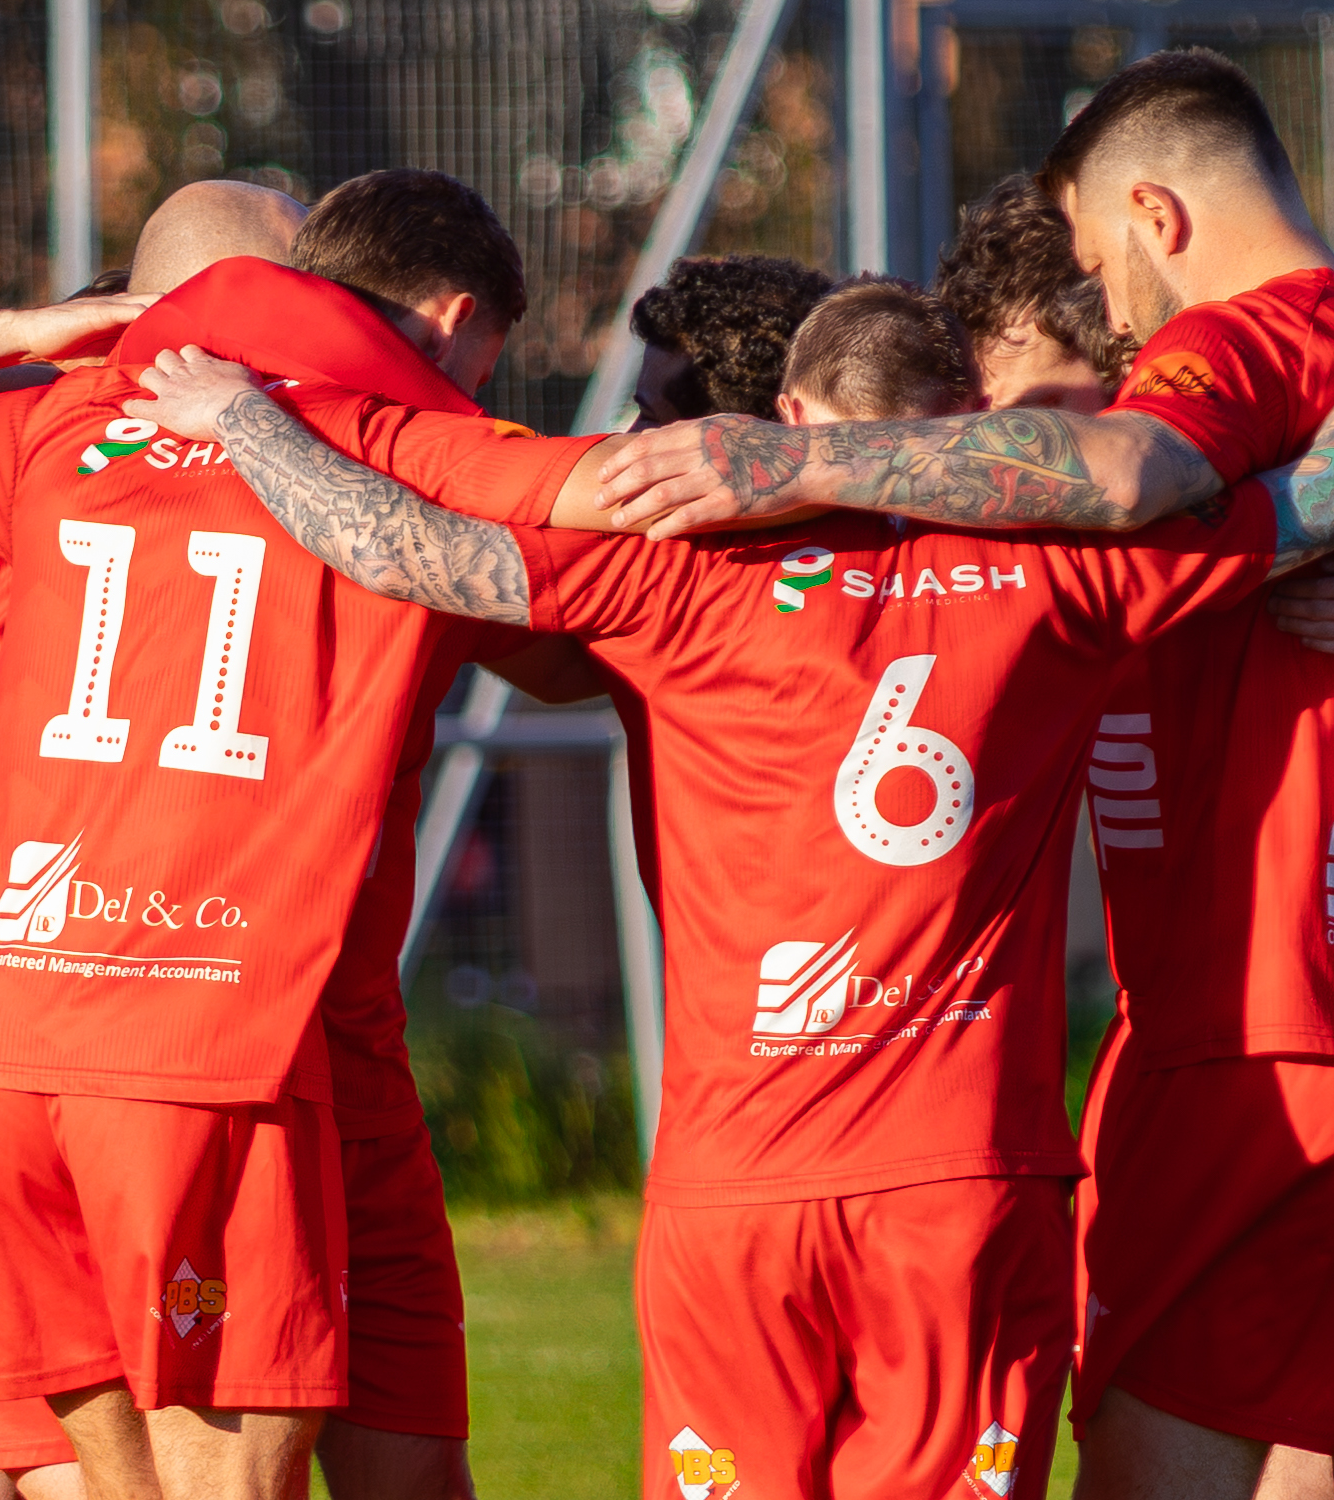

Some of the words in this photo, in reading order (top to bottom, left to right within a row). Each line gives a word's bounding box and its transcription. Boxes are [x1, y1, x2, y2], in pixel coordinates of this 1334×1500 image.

[38, 518, 270, 781] 11
[833, 653, 976, 868] 6
[69, 879, 134, 923] Del
[141, 890, 184, 930] &
[195, 896, 248, 929] Co.
[48, 956, 146, 978] Management
[147, 963, 242, 984] Accountant
[847, 974, 913, 1010] Del
[750, 1042, 825, 1058] Chartered
[165, 1277, 227, 1318] PBS
